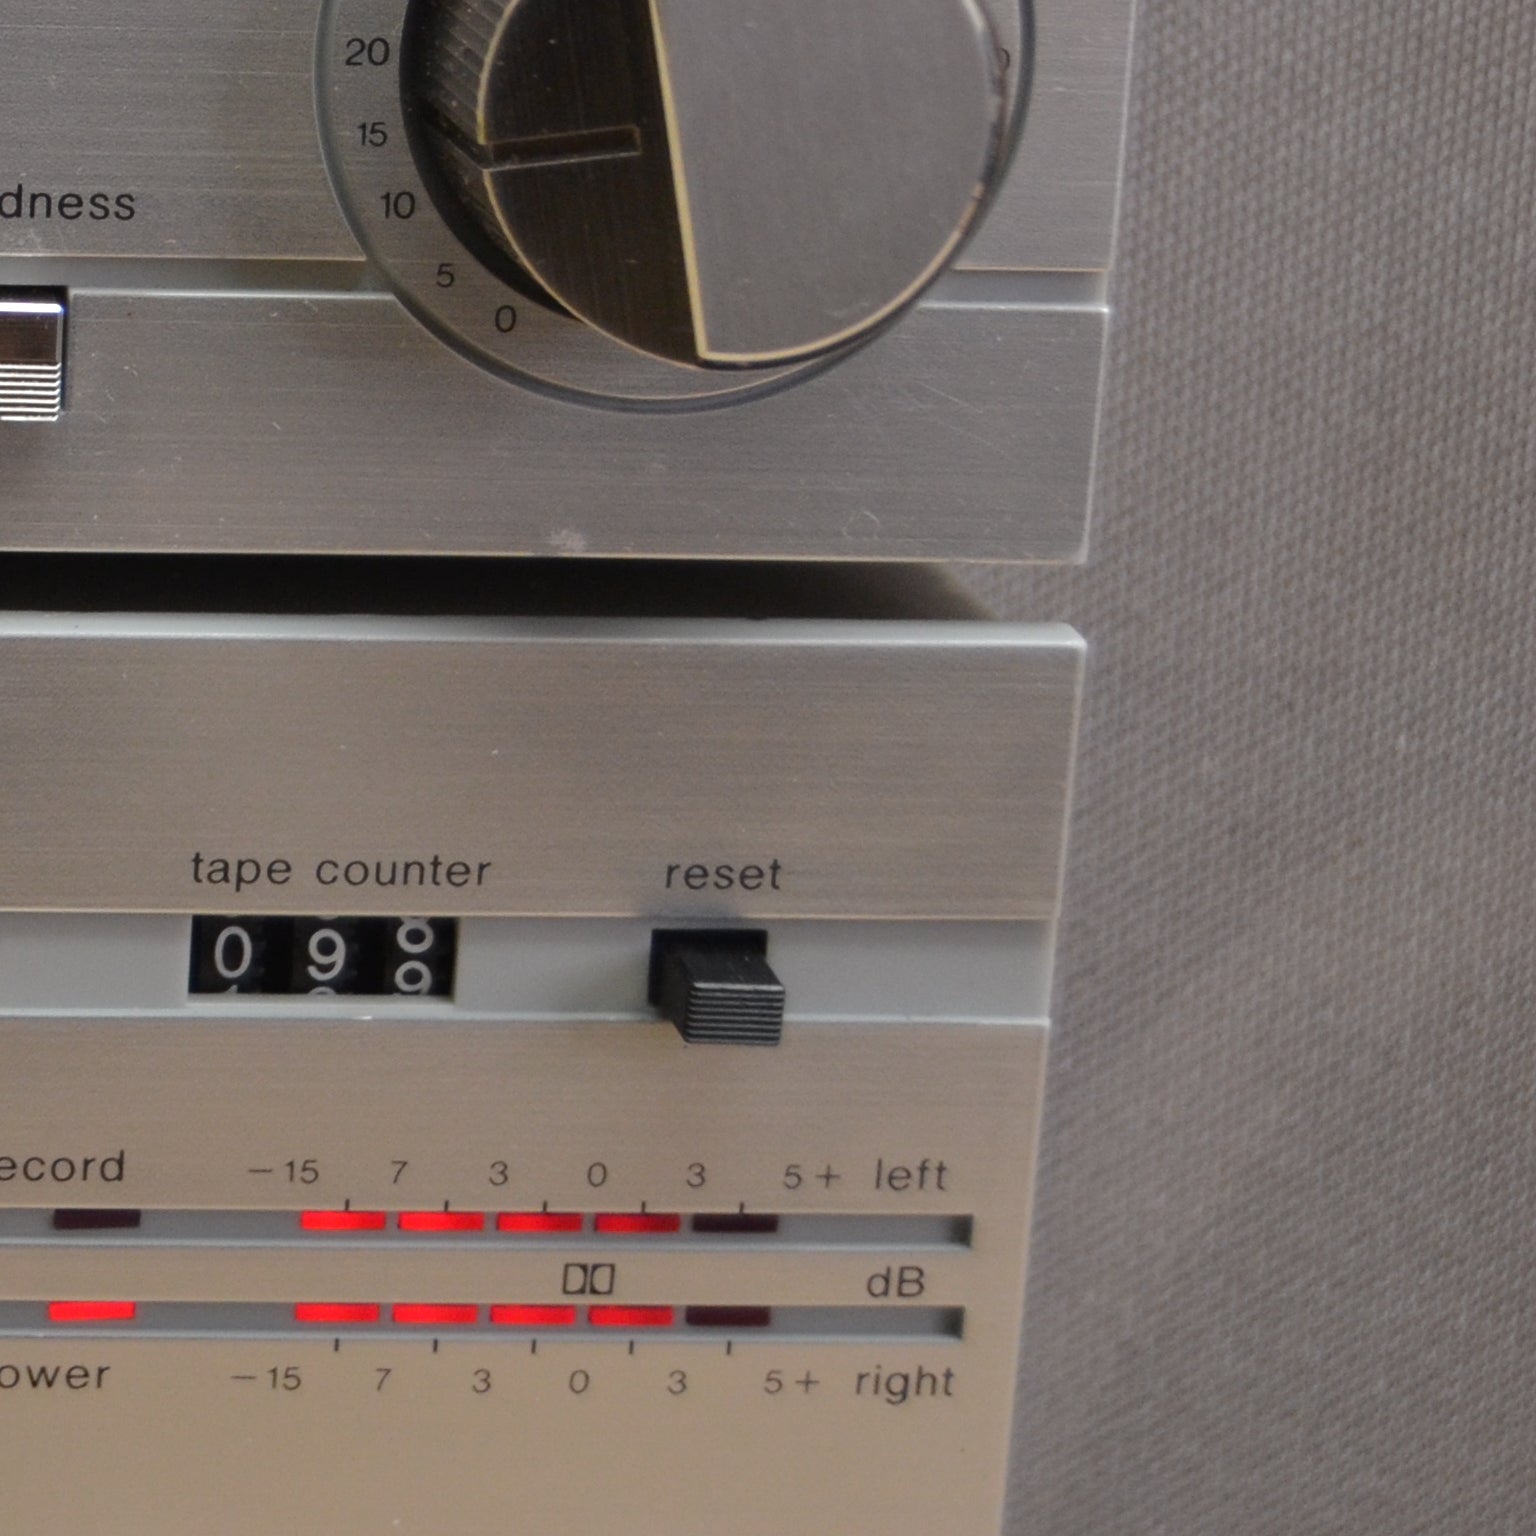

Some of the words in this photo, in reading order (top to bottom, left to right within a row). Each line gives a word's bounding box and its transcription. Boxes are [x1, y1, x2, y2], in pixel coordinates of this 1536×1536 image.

[344, 36, 391, 67] 20
[358, 121, 389, 148] 15
[381, 190, 417, 220] 10
[436, 262, 456, 289] 5
[494, 304, 518, 334] 0
[191, 851, 292, 893] tape
[315, 854, 492, 888] counter
[665, 858, 782, 891] reset
[391, 1160, 409, 1185] 7
[488, 1160, 510, 1187] 3
[586, 1161, 609, 1189] 0
[685, 1162, 707, 1190] 3
[874, 1158, 948, 1192] left
[866, 1265, 925, 1299] dB
[375, 1367, 393, 1392] 7
[471, 1368, 492, 1395] 3
[568, 1369, 591, 1396] 0
[667, 1369, 688, 1396] 3
[855, 1365, 955, 1406] right
